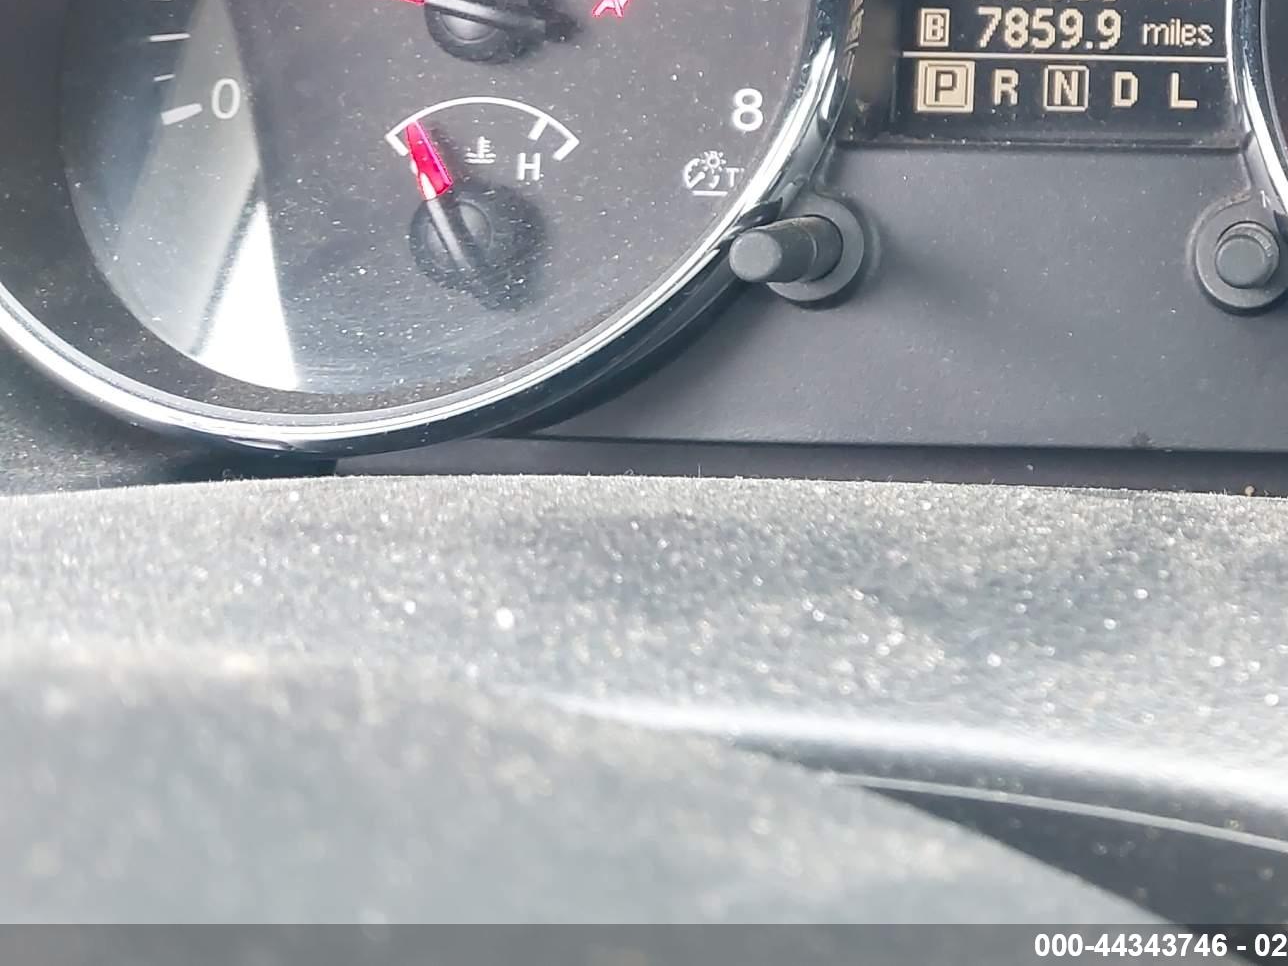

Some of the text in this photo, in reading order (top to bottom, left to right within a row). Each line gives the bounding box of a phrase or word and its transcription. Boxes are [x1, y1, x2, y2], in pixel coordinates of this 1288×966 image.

[926, 7, 1213, 51] B 7859.9 miles
[212, 79, 241, 119] 0
[935, 69, 1198, 108] P R N D L
[732, 89, 763, 133] 8
[516, 152, 545, 181] H
